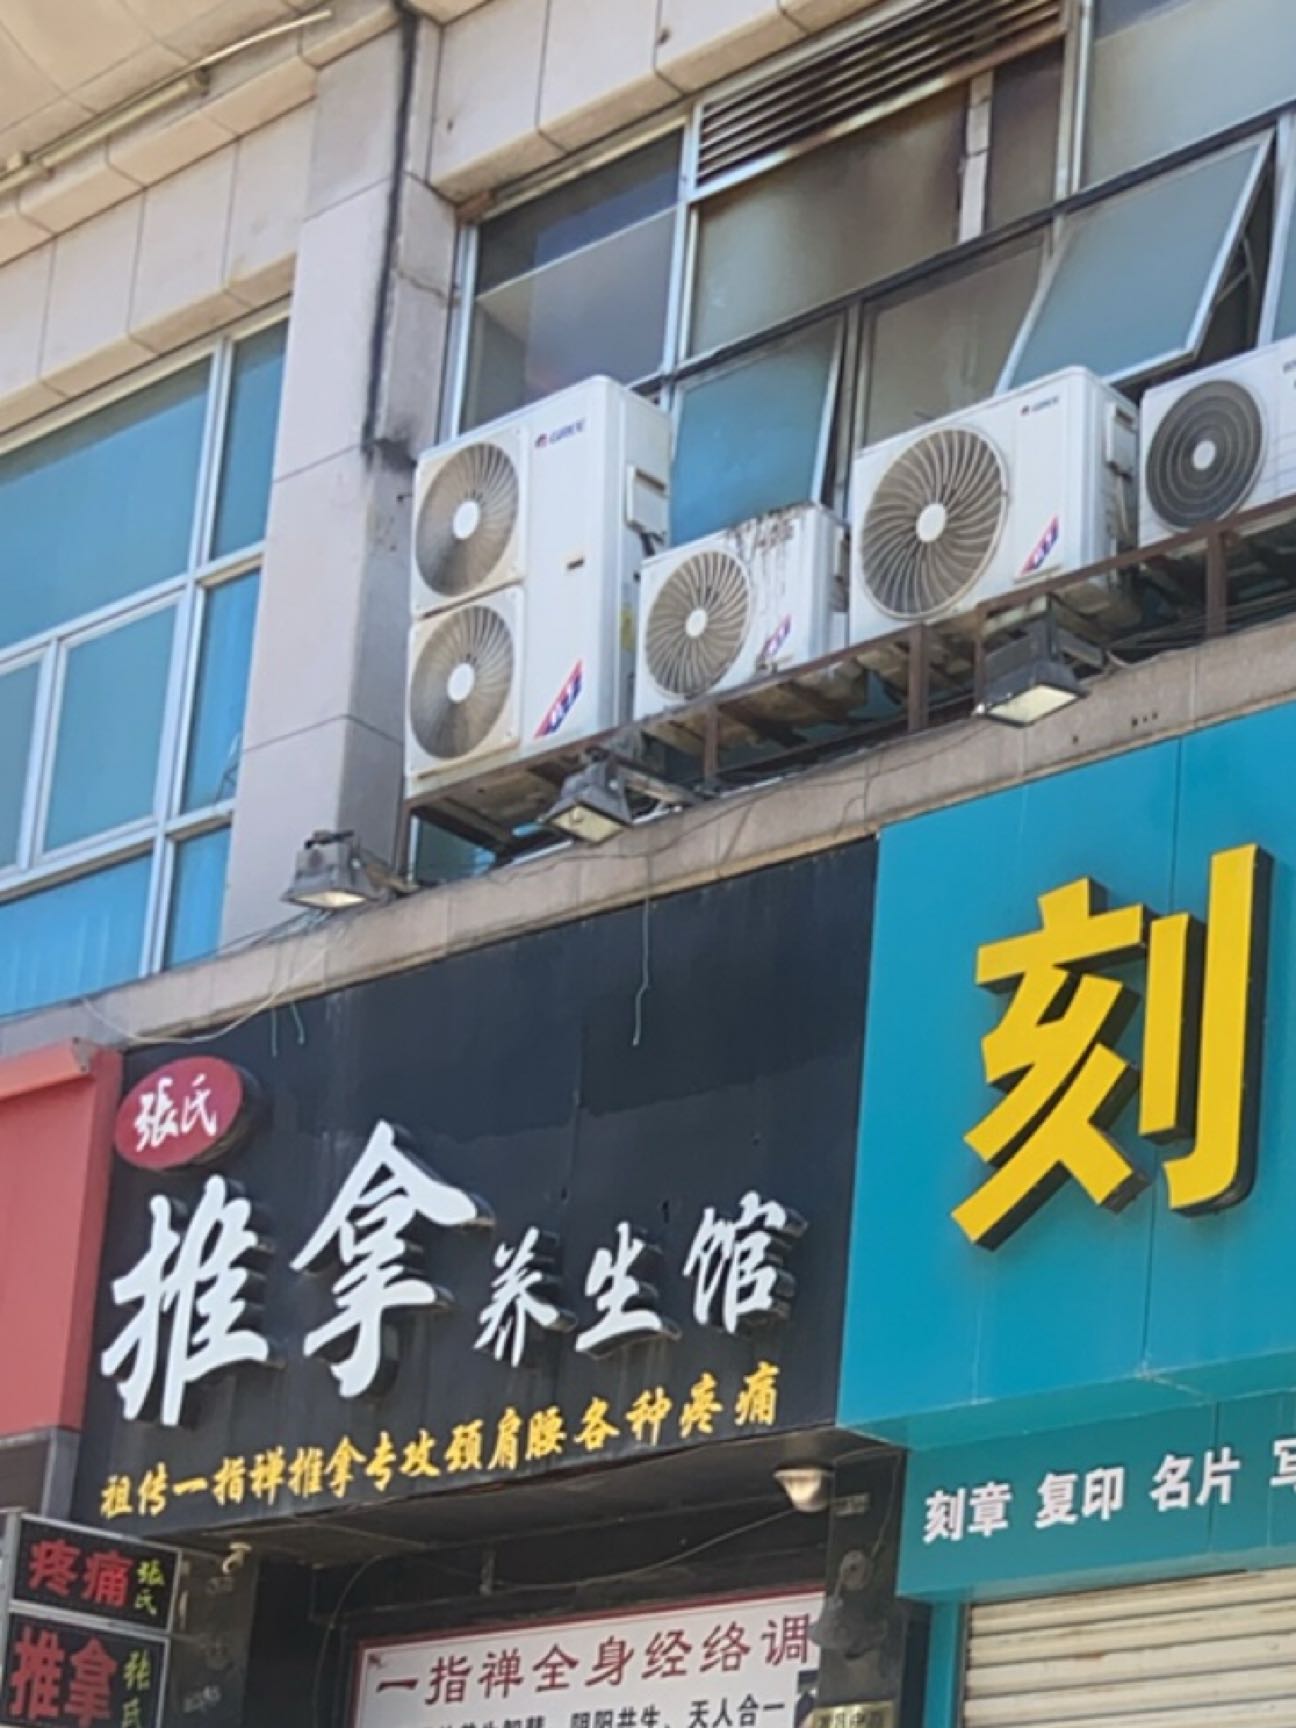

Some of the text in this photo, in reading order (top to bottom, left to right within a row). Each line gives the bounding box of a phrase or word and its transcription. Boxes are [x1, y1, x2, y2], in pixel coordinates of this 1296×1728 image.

[922, 1480, 1010, 1545] 刻章
[1034, 1464, 1125, 1530] 复印
[1149, 1449, 1241, 1512] 名片
[28, 1539, 133, 1607] 疼痛
[9, 1624, 118, 1728] 推拿
[376, 1612, 811, 1706] 一指禅全身经络调
